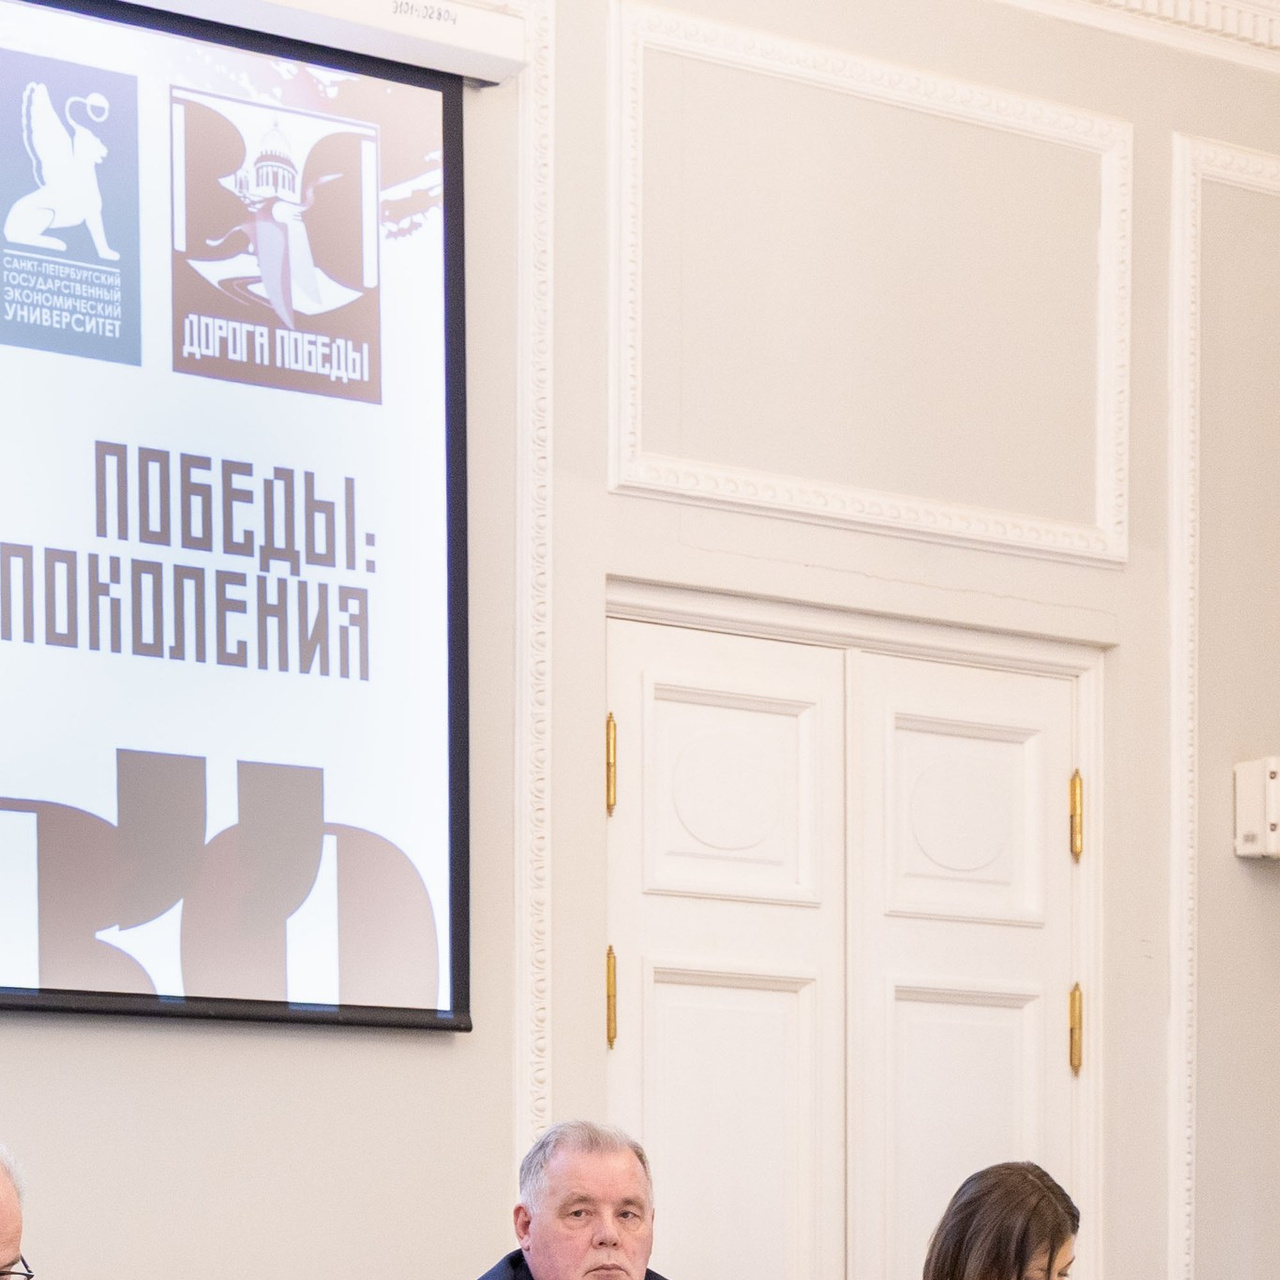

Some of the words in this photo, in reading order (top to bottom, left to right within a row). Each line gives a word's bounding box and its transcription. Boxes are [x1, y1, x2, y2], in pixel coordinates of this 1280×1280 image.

[3, 257, 121, 286] САНКТ-ПЕТЕРБУРГСКИЙ
[3, 271, 121, 302] ГОСУДАРСТВЕННЫЙ
[4, 287, 121, 319] ЭКОНОМИЧЕСКИЙ
[4, 302, 121, 339] УНИВЕРСИТЕТ
[183, 314, 269, 367] ДОРОГА
[275, 328, 369, 383] ПОБЕДЫ
[94, 440, 376, 577] ПОБЕДЫ:
[0, 541, 370, 681] ПОКОЛЕНИЯ
